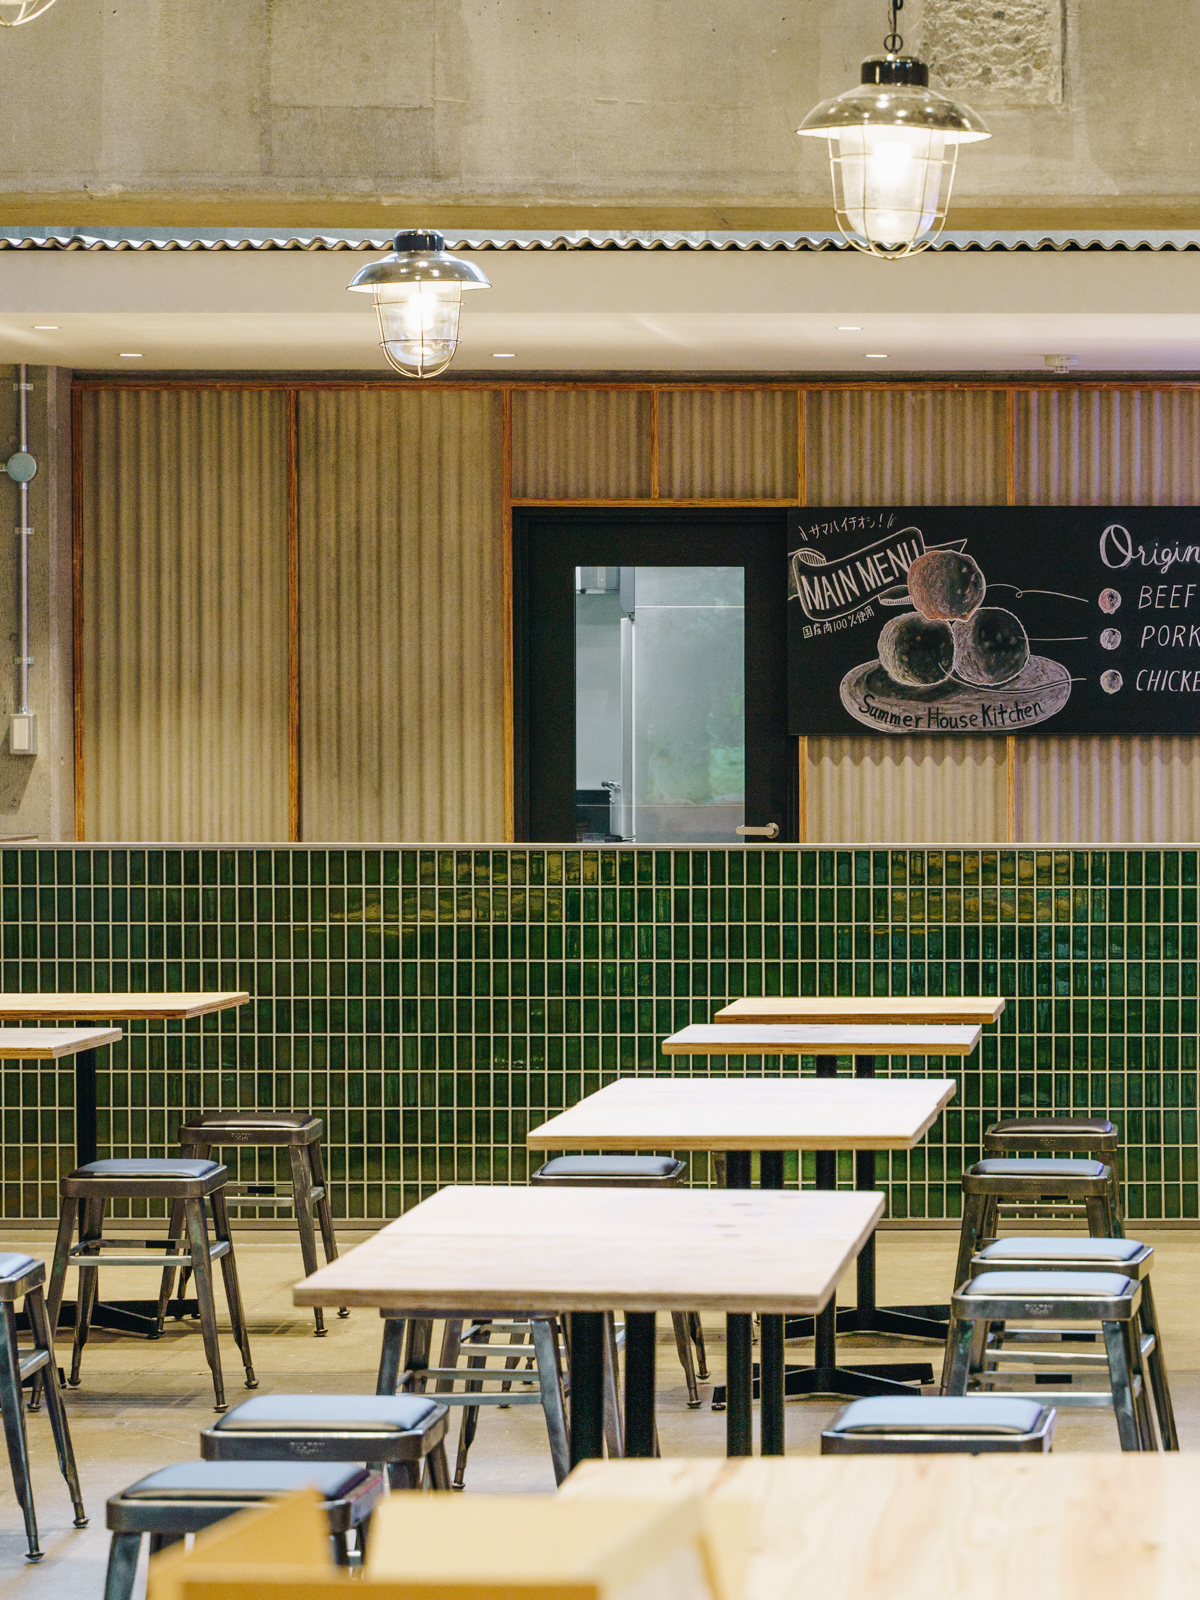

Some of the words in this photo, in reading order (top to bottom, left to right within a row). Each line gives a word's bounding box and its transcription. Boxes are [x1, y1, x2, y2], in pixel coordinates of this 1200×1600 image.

[801, 564, 860, 610] MAIN
[1138, 584, 1197, 610] BEEF
[858, 694, 923, 729] Summer
[927, 707, 984, 729] House
[981, 701, 1044, 728] Kitchen
